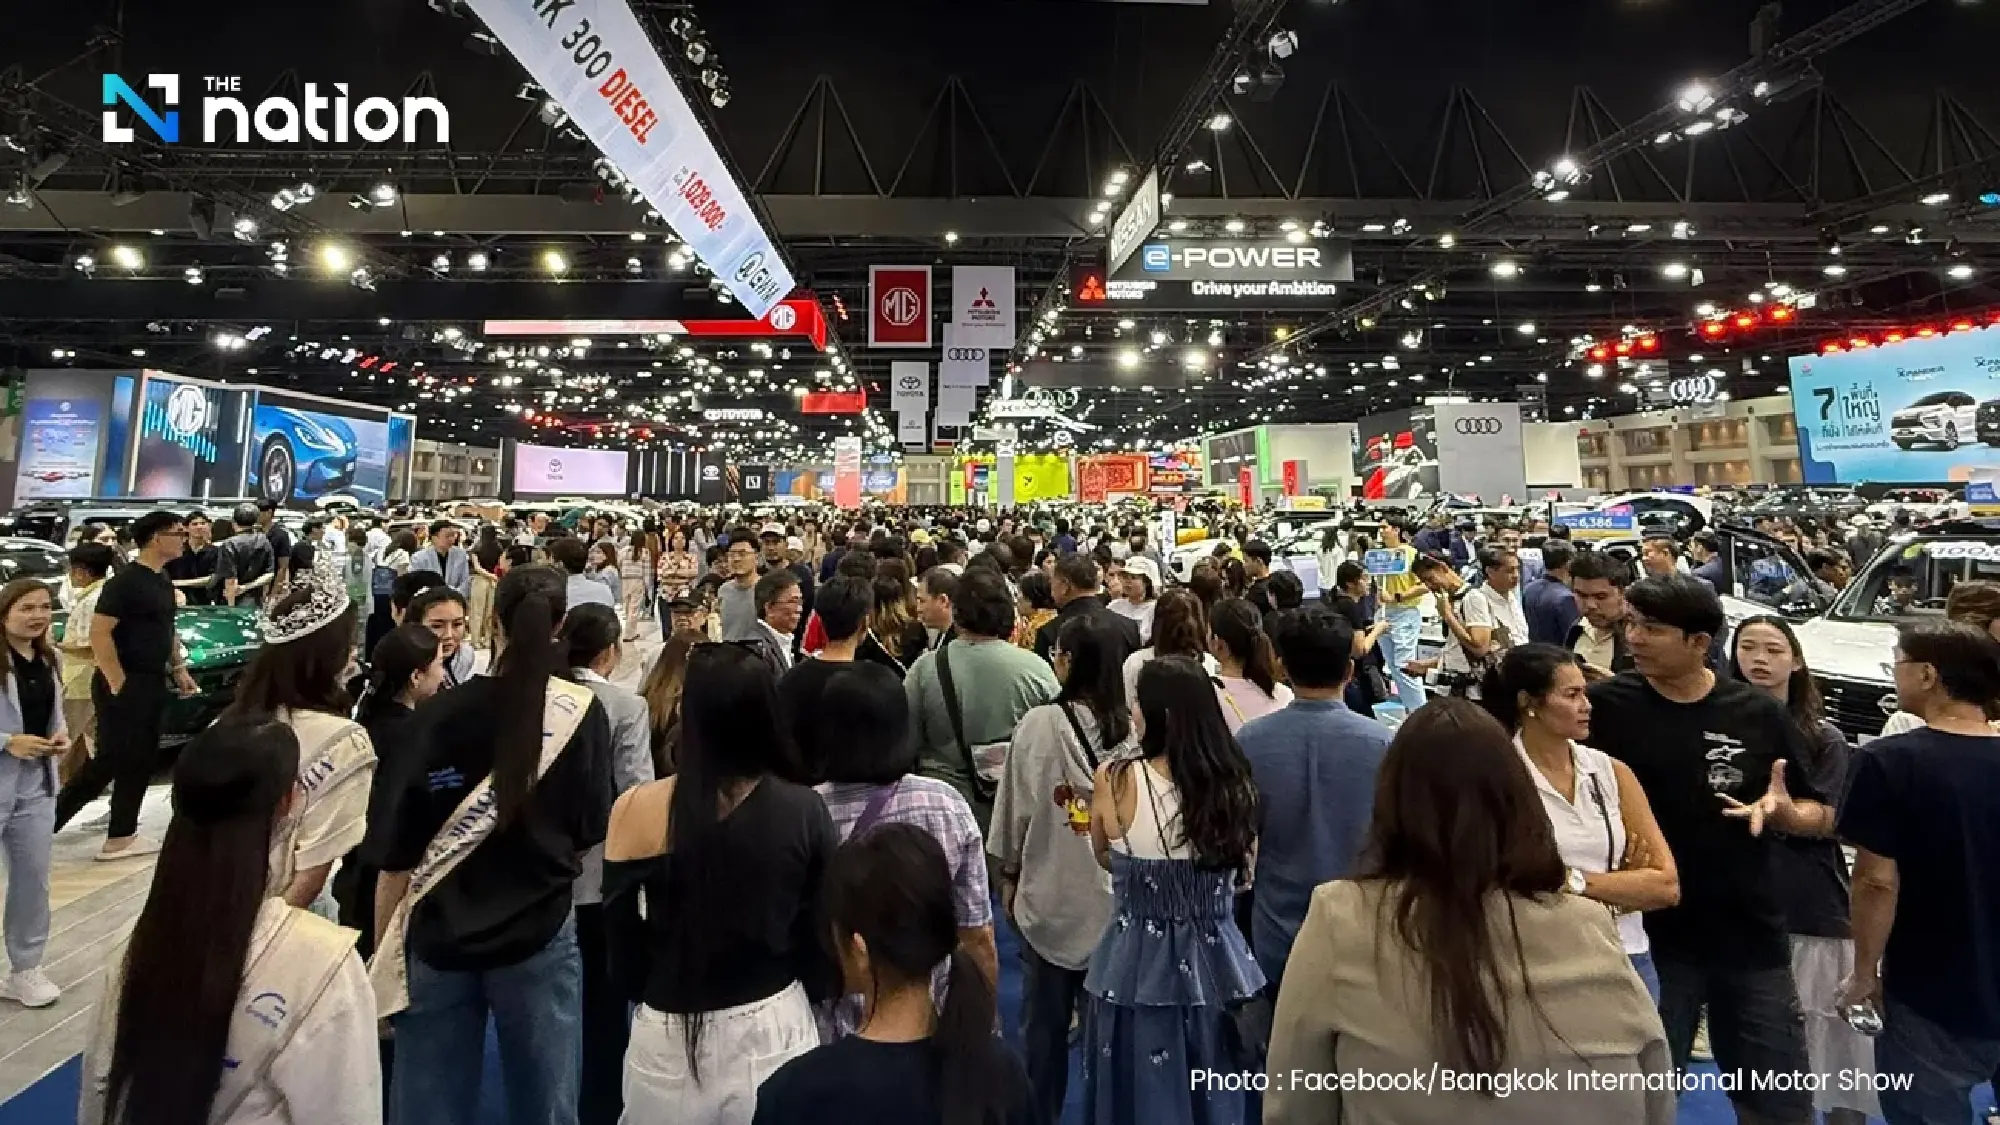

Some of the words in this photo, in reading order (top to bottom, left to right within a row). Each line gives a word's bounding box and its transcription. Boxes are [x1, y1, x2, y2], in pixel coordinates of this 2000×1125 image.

[561, 17, 612, 78] 300
[598, 67, 658, 144] DIESEL
[1110, 190, 1152, 263] NISSAN
[1146, 246, 1323, 269] e-POWER
[1191, 280, 1231, 296] Drive
[1232, 283, 1268, 299] your
[1268, 280, 1336, 296] Ambition
[884, 290, 917, 323] MG
[1812, 387, 1835, 421] 7
